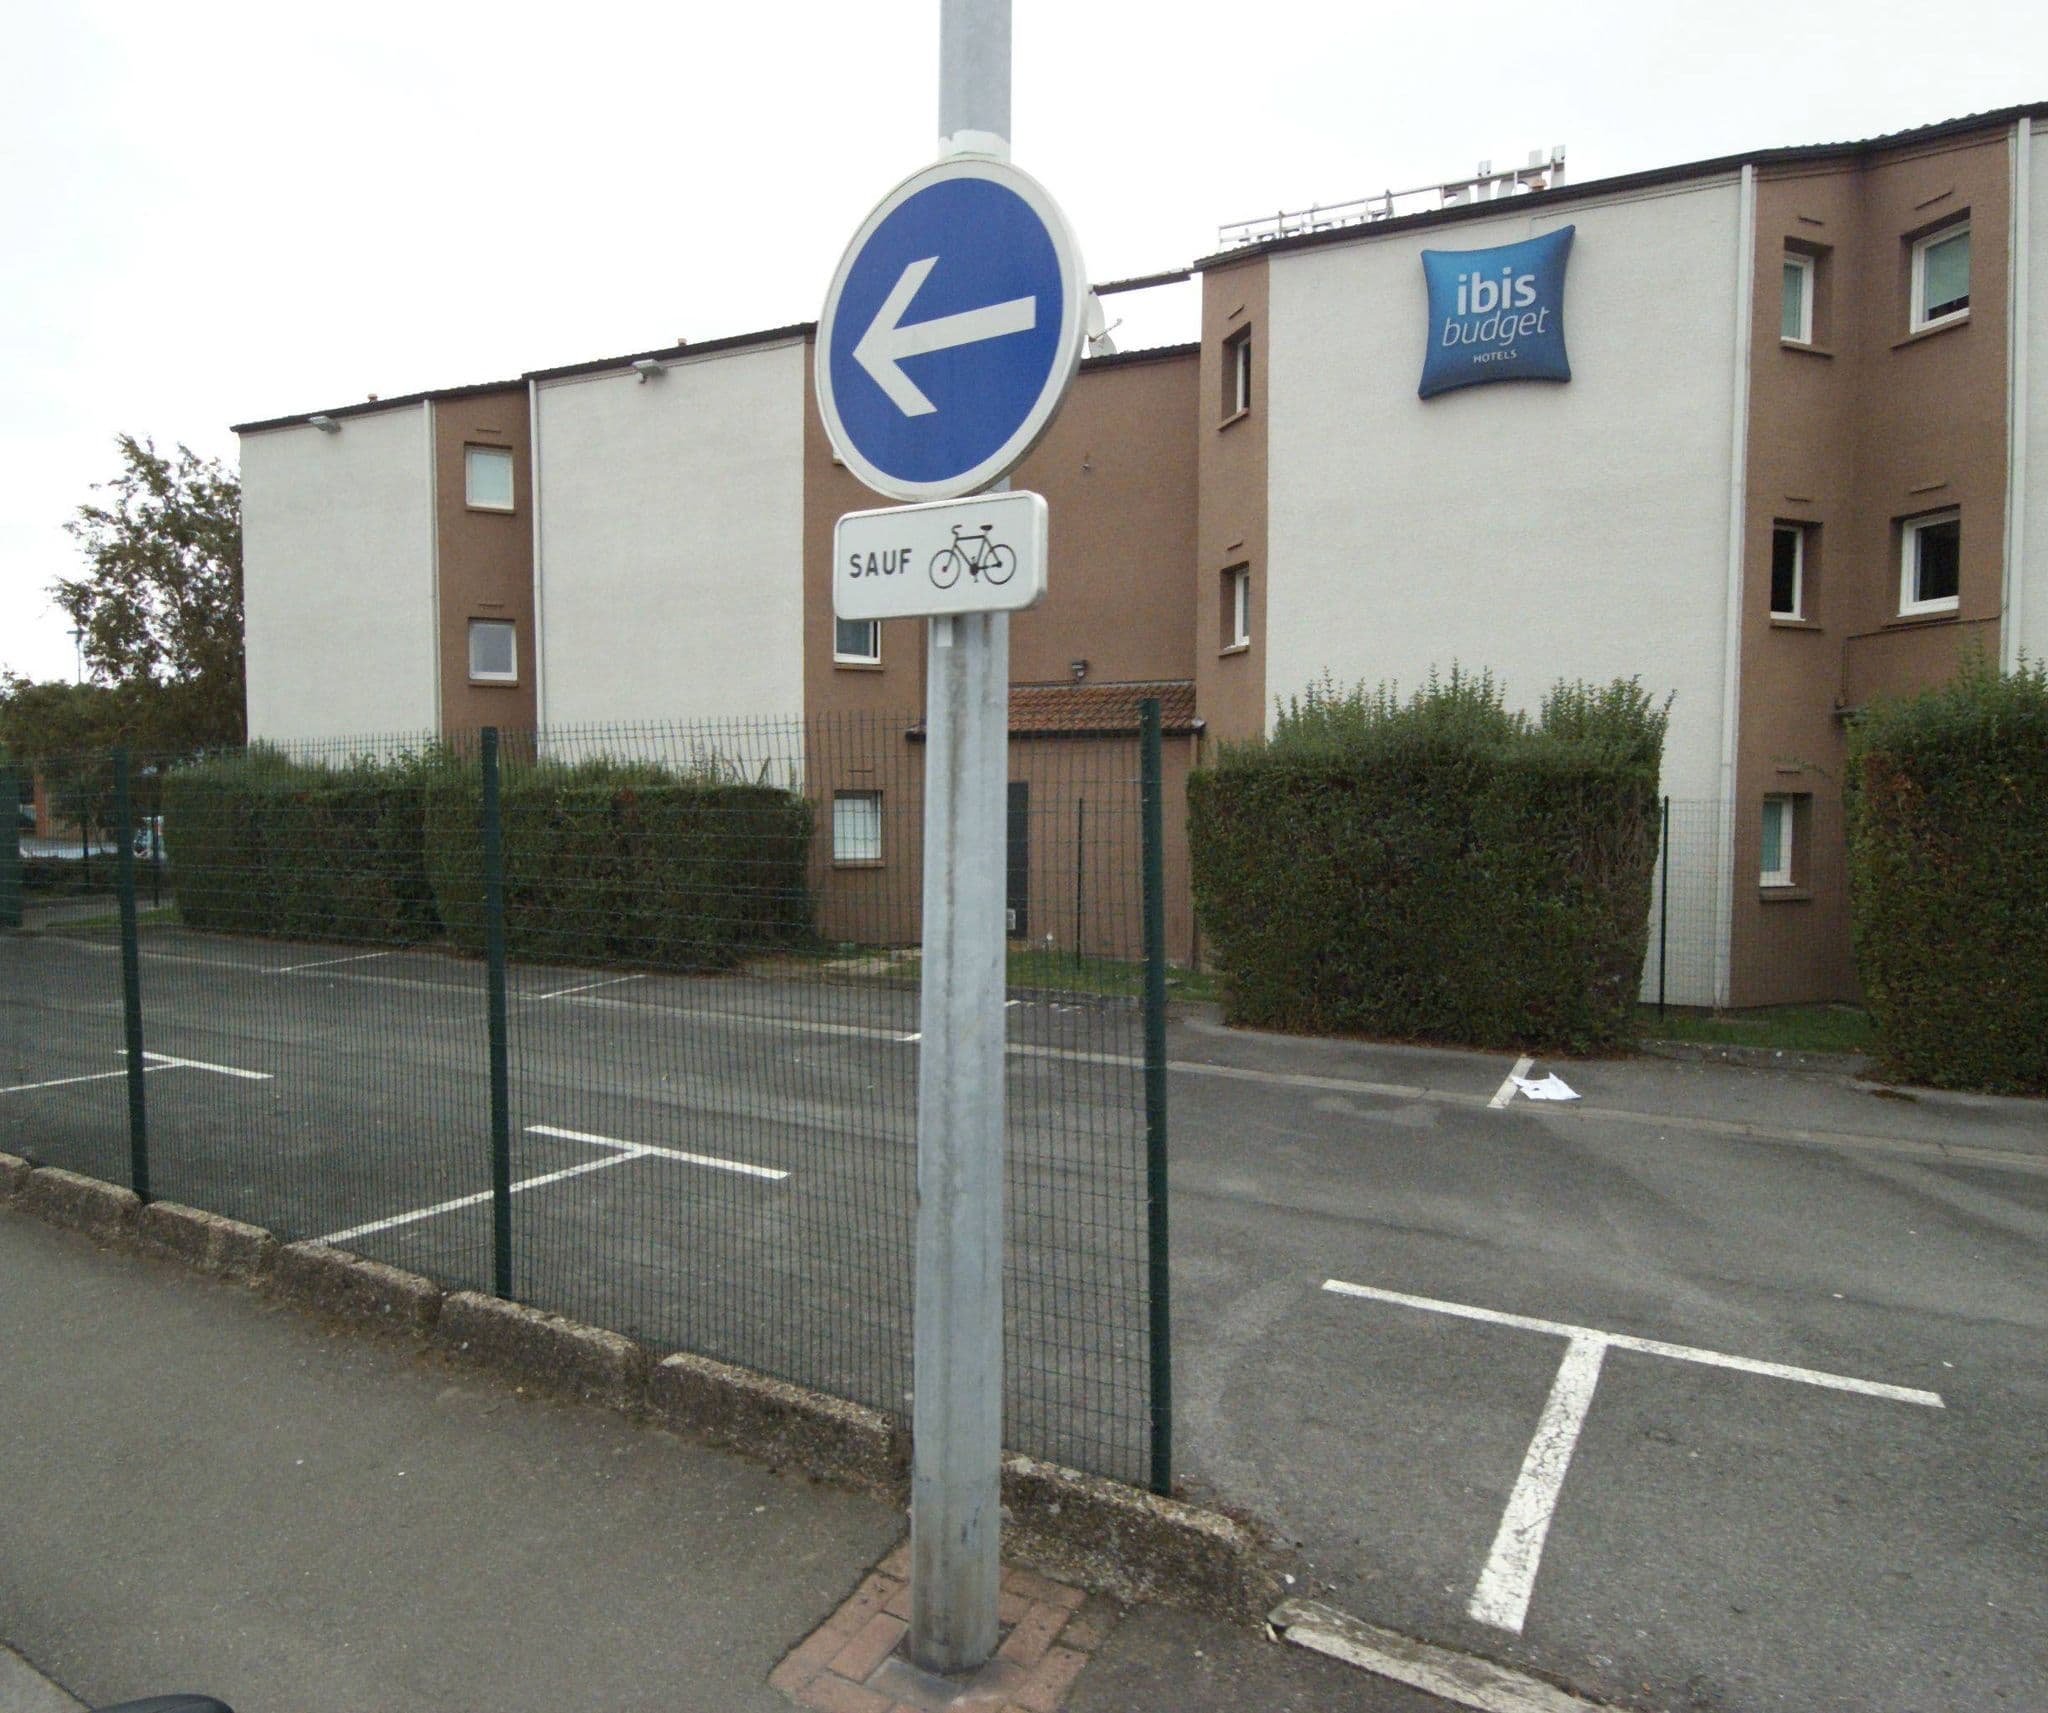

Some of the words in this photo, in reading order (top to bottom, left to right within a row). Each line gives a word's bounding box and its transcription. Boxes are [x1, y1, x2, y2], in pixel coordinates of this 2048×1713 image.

[1457, 266, 1537, 315] ibis
[1442, 306, 1550, 347] budget
[1473, 350, 1518, 364] HOTELS
[849, 548, 912, 578] SAUF
